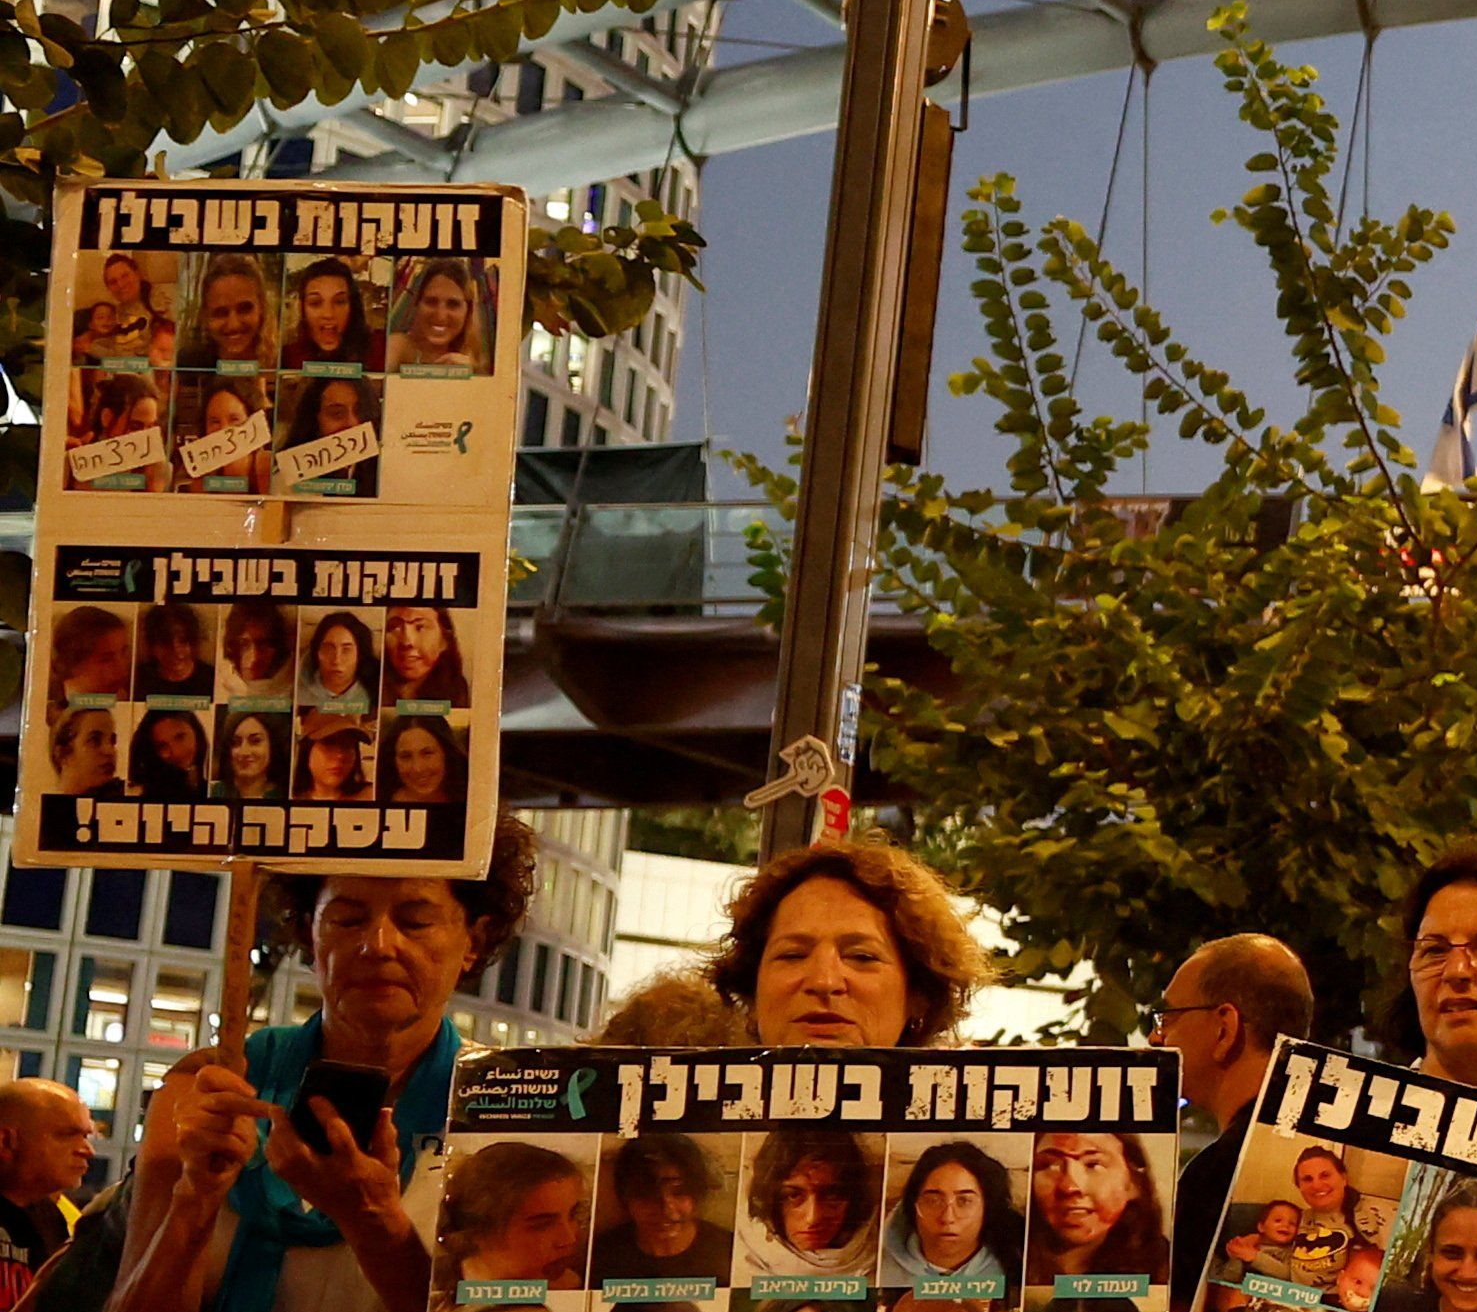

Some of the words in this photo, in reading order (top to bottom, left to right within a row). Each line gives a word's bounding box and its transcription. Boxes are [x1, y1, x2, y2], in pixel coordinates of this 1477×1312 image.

[98, 192, 280, 251] בשבילן
[293, 199, 480, 255] זועקות
[293, 433, 368, 478] נרצחה!
[154, 552, 298, 605] בשבילן
[313, 559, 458, 603] זועקות
[76, 797, 228, 843] היום!
[242, 805, 427, 853] עסקה
[523, 1069, 560, 1080] נשים
[510, 1084, 558, 1095] עושות
[617, 1056, 881, 1139] בשבילן
[908, 1066, 1156, 1130] זועקות
[518, 1096, 556, 1109] שלום
[654, 1283, 711, 1297] דניאלה
[813, 1279, 859, 1295] קרינה
[967, 1278, 996, 1293] לירי
[1073, 1277, 1093, 1292] לוי
[1097, 1279, 1138, 1293] נעמה
[1248, 1279, 1284, 1297] ביבס
[1287, 1287, 1319, 1305] שירי
